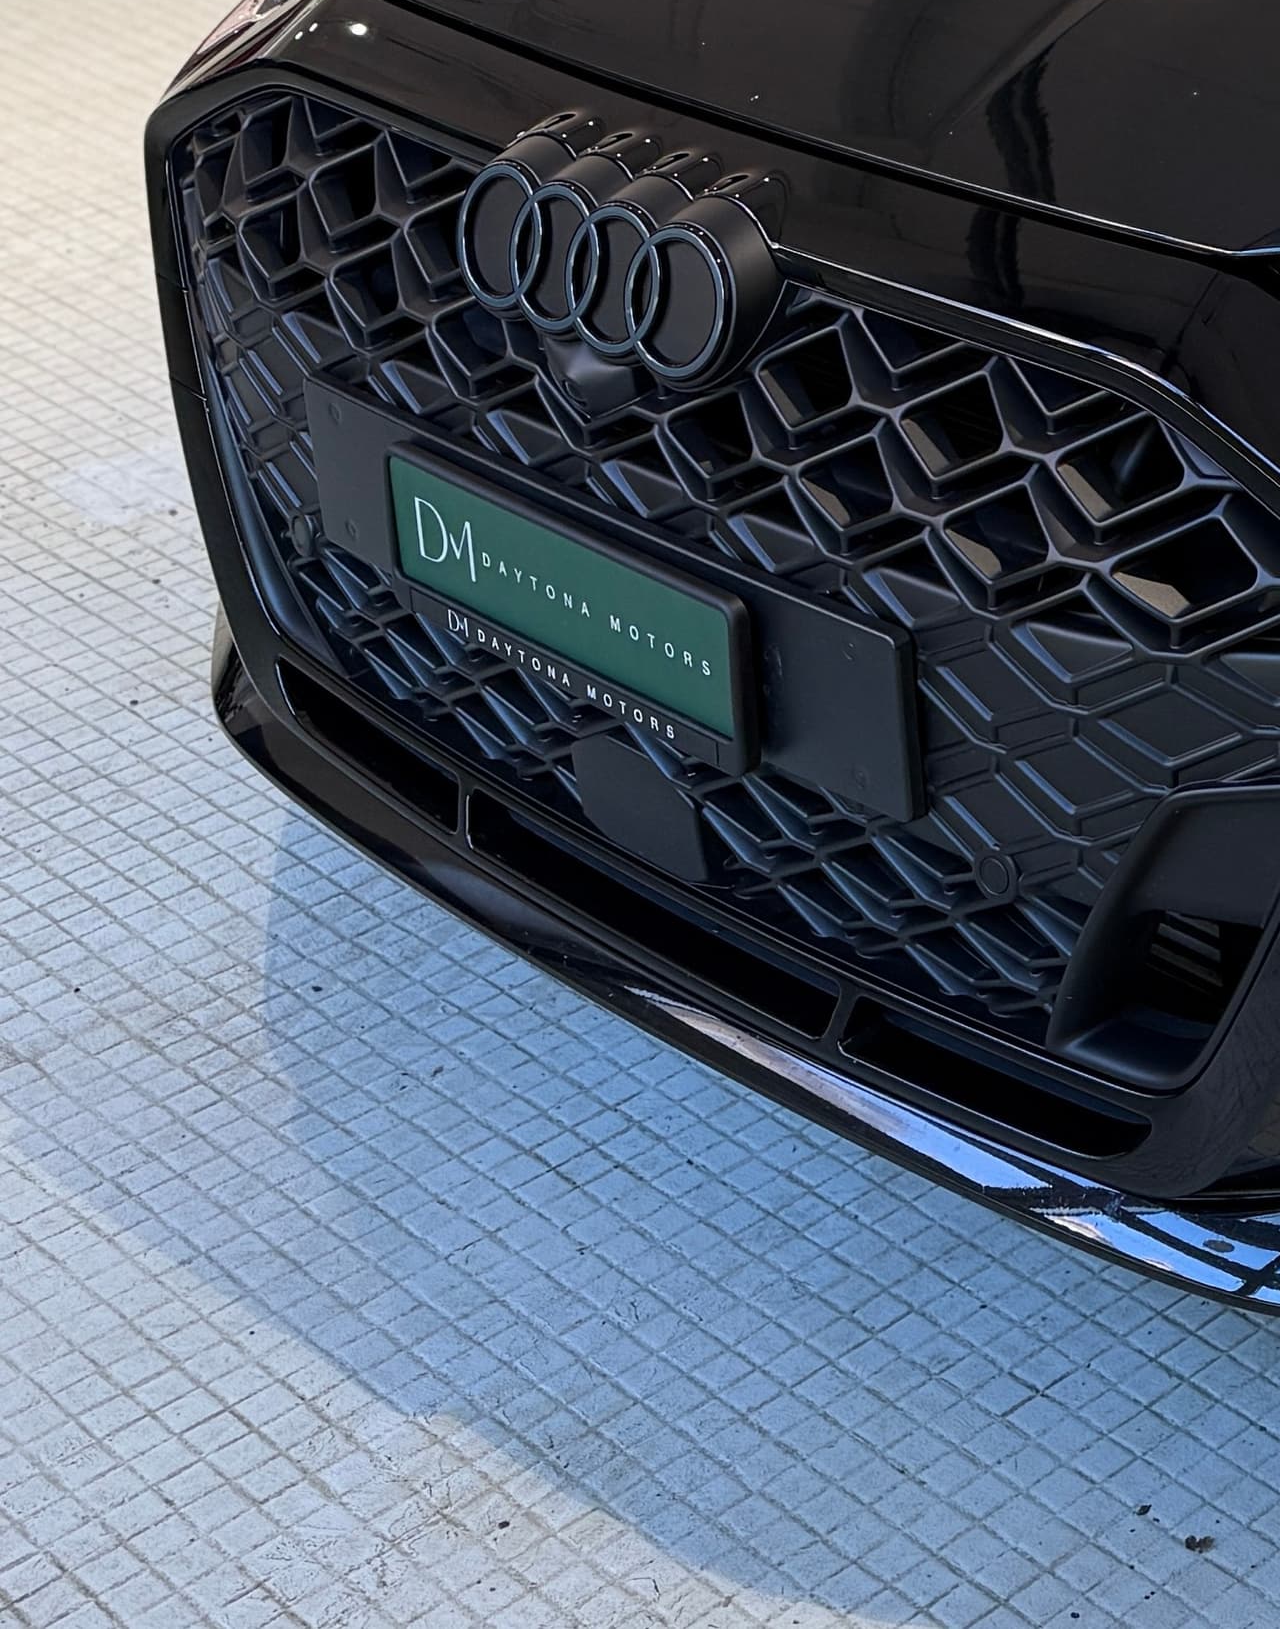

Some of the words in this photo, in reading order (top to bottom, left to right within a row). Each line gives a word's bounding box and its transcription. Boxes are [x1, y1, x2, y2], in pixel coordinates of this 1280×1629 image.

[481, 551, 591, 618] DAYTONA
[609, 614, 712, 677] MOTORS
[477, 629, 571, 688] DAYTONA
[586, 684, 676, 740] MOTORS
